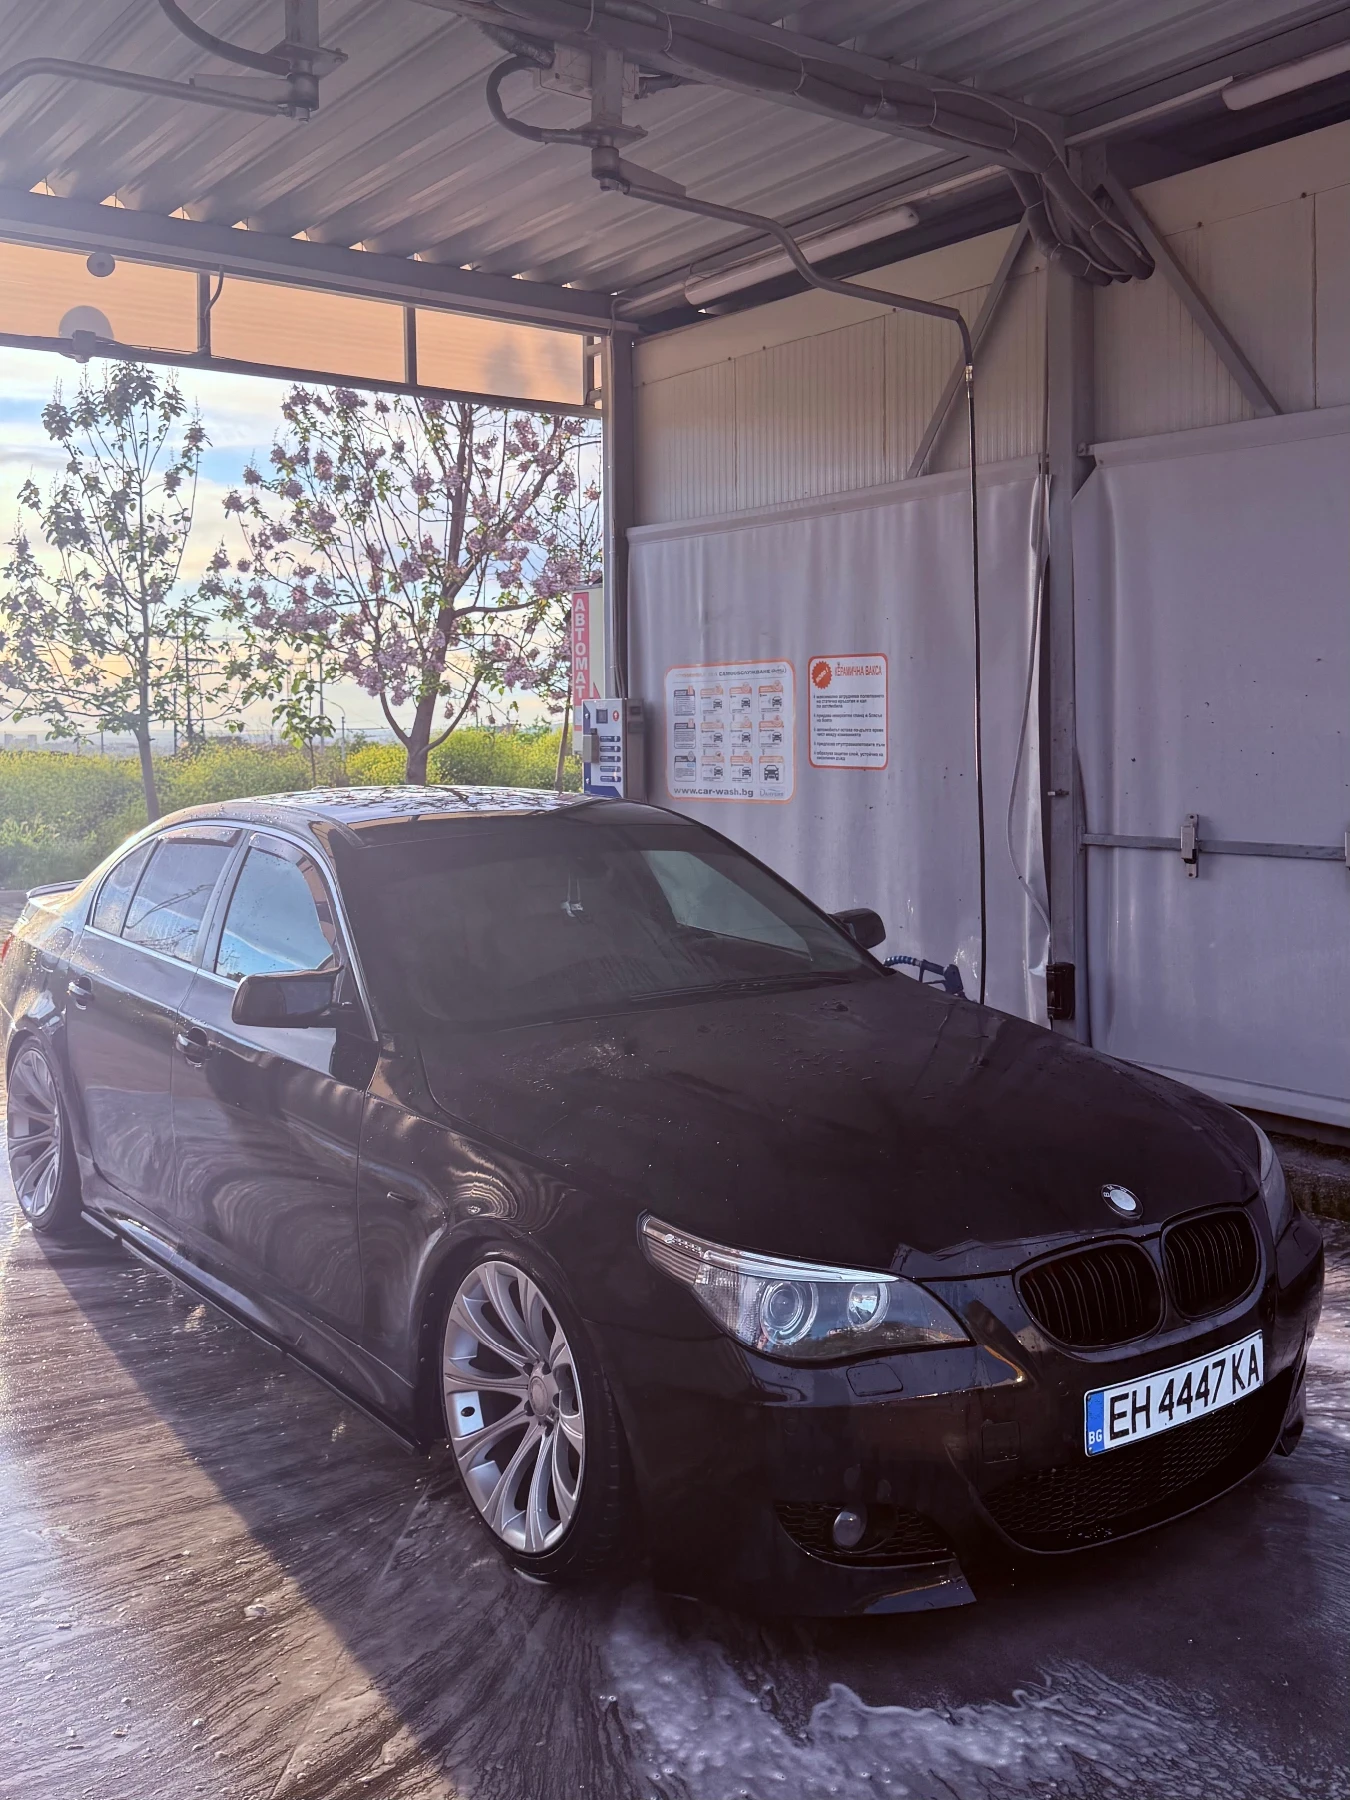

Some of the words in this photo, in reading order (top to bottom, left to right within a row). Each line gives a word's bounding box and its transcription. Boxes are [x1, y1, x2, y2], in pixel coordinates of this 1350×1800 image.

[574, 598, 588, 698] АВТОМАТ
[835, 665, 864, 676] КЕРАМИЧНА
[865, 665, 882, 676] ВАКСА
[674, 788, 754, 797] www.car-wash.bg
[1088, 1430, 1102, 1445] BG
[1109, 1386, 1151, 1441] EH
[1158, 1358, 1226, 1421] 4447
[1232, 1344, 1260, 1395] KA
